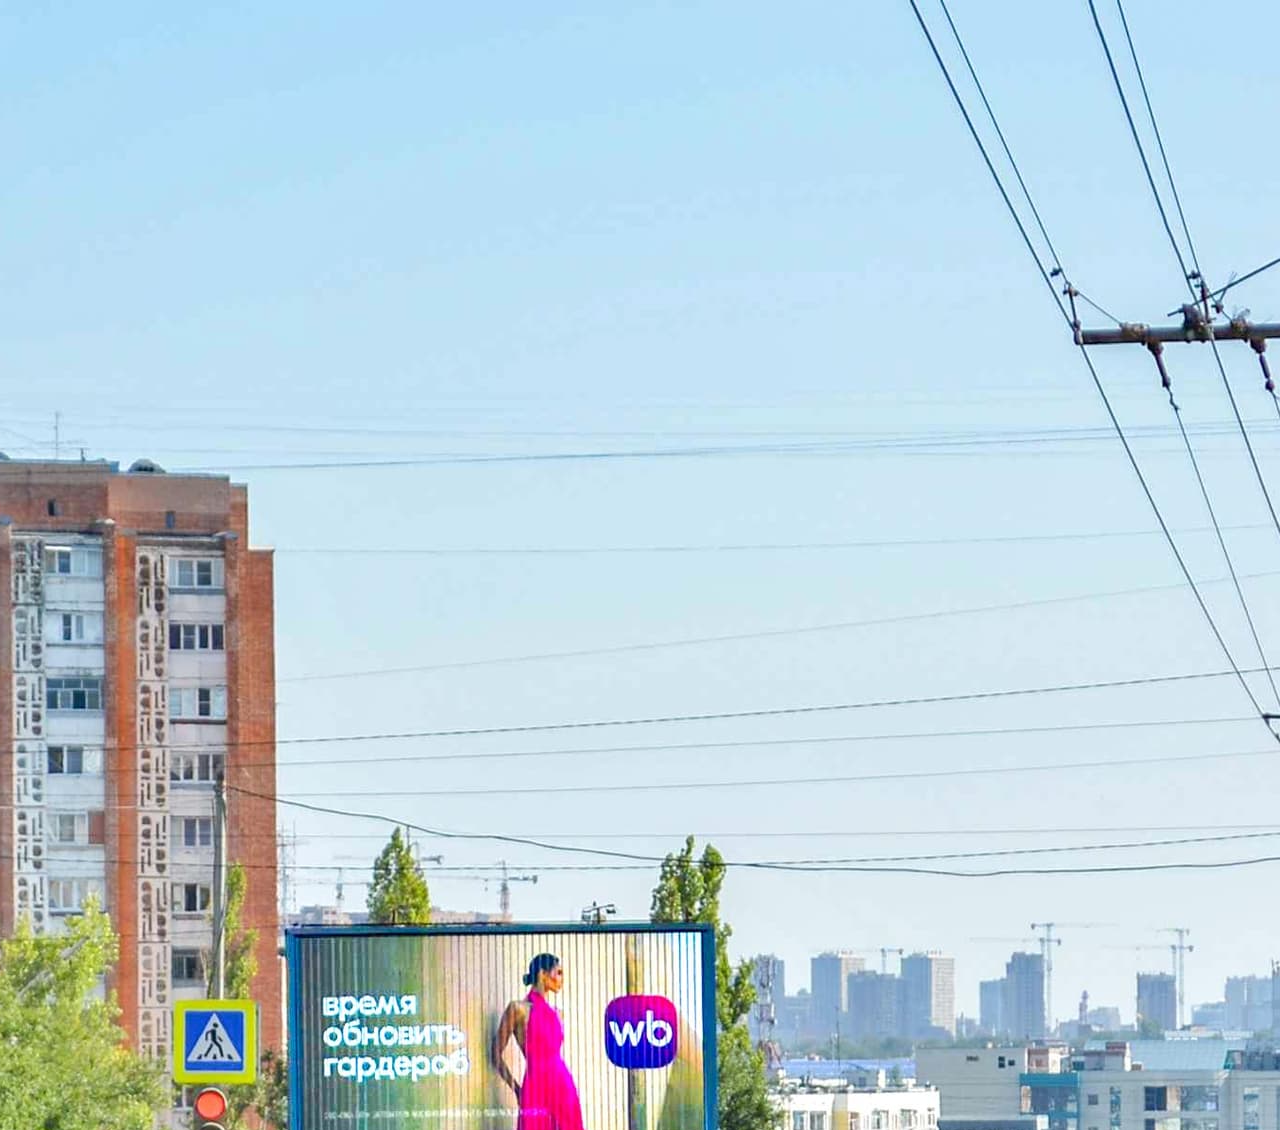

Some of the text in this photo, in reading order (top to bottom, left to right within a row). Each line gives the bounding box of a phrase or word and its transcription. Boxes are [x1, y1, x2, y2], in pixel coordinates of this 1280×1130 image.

[322, 994, 417, 1021] время
[322, 1020, 465, 1047] обновить
[608, 1009, 674, 1048] wb
[322, 1051, 471, 1082] гардероб
